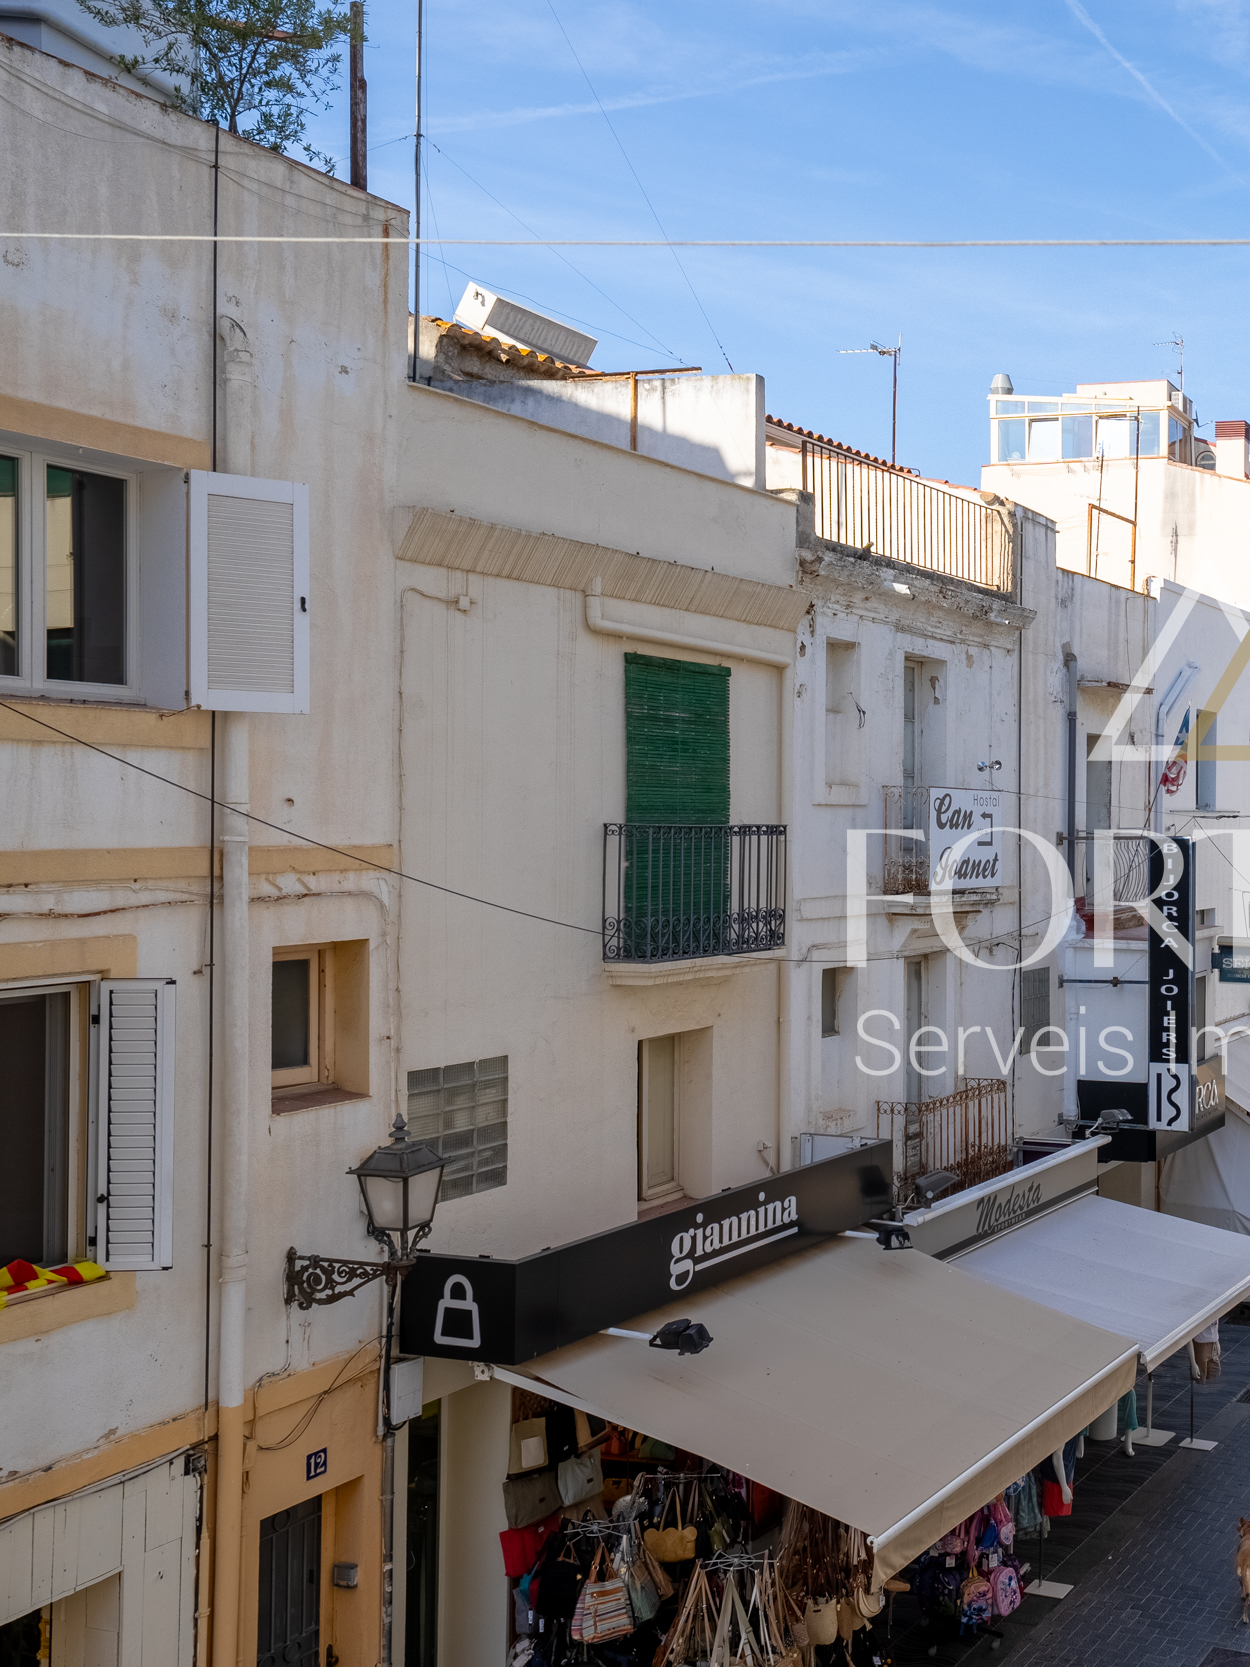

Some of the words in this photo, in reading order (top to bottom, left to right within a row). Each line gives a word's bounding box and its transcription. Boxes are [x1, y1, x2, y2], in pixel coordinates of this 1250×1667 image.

[933, 793, 975, 830] Can
[973, 794, 1000, 807] Hostal
[933, 846, 999, 886] Joanet
[1160, 842, 1179, 948] BIJORCA
[1160, 968, 1179, 1059] JOIERS
[975, 1180, 1043, 1236] Modesta
[669, 1191, 799, 1291] giannina
[309, 1452, 325, 1477] 12
